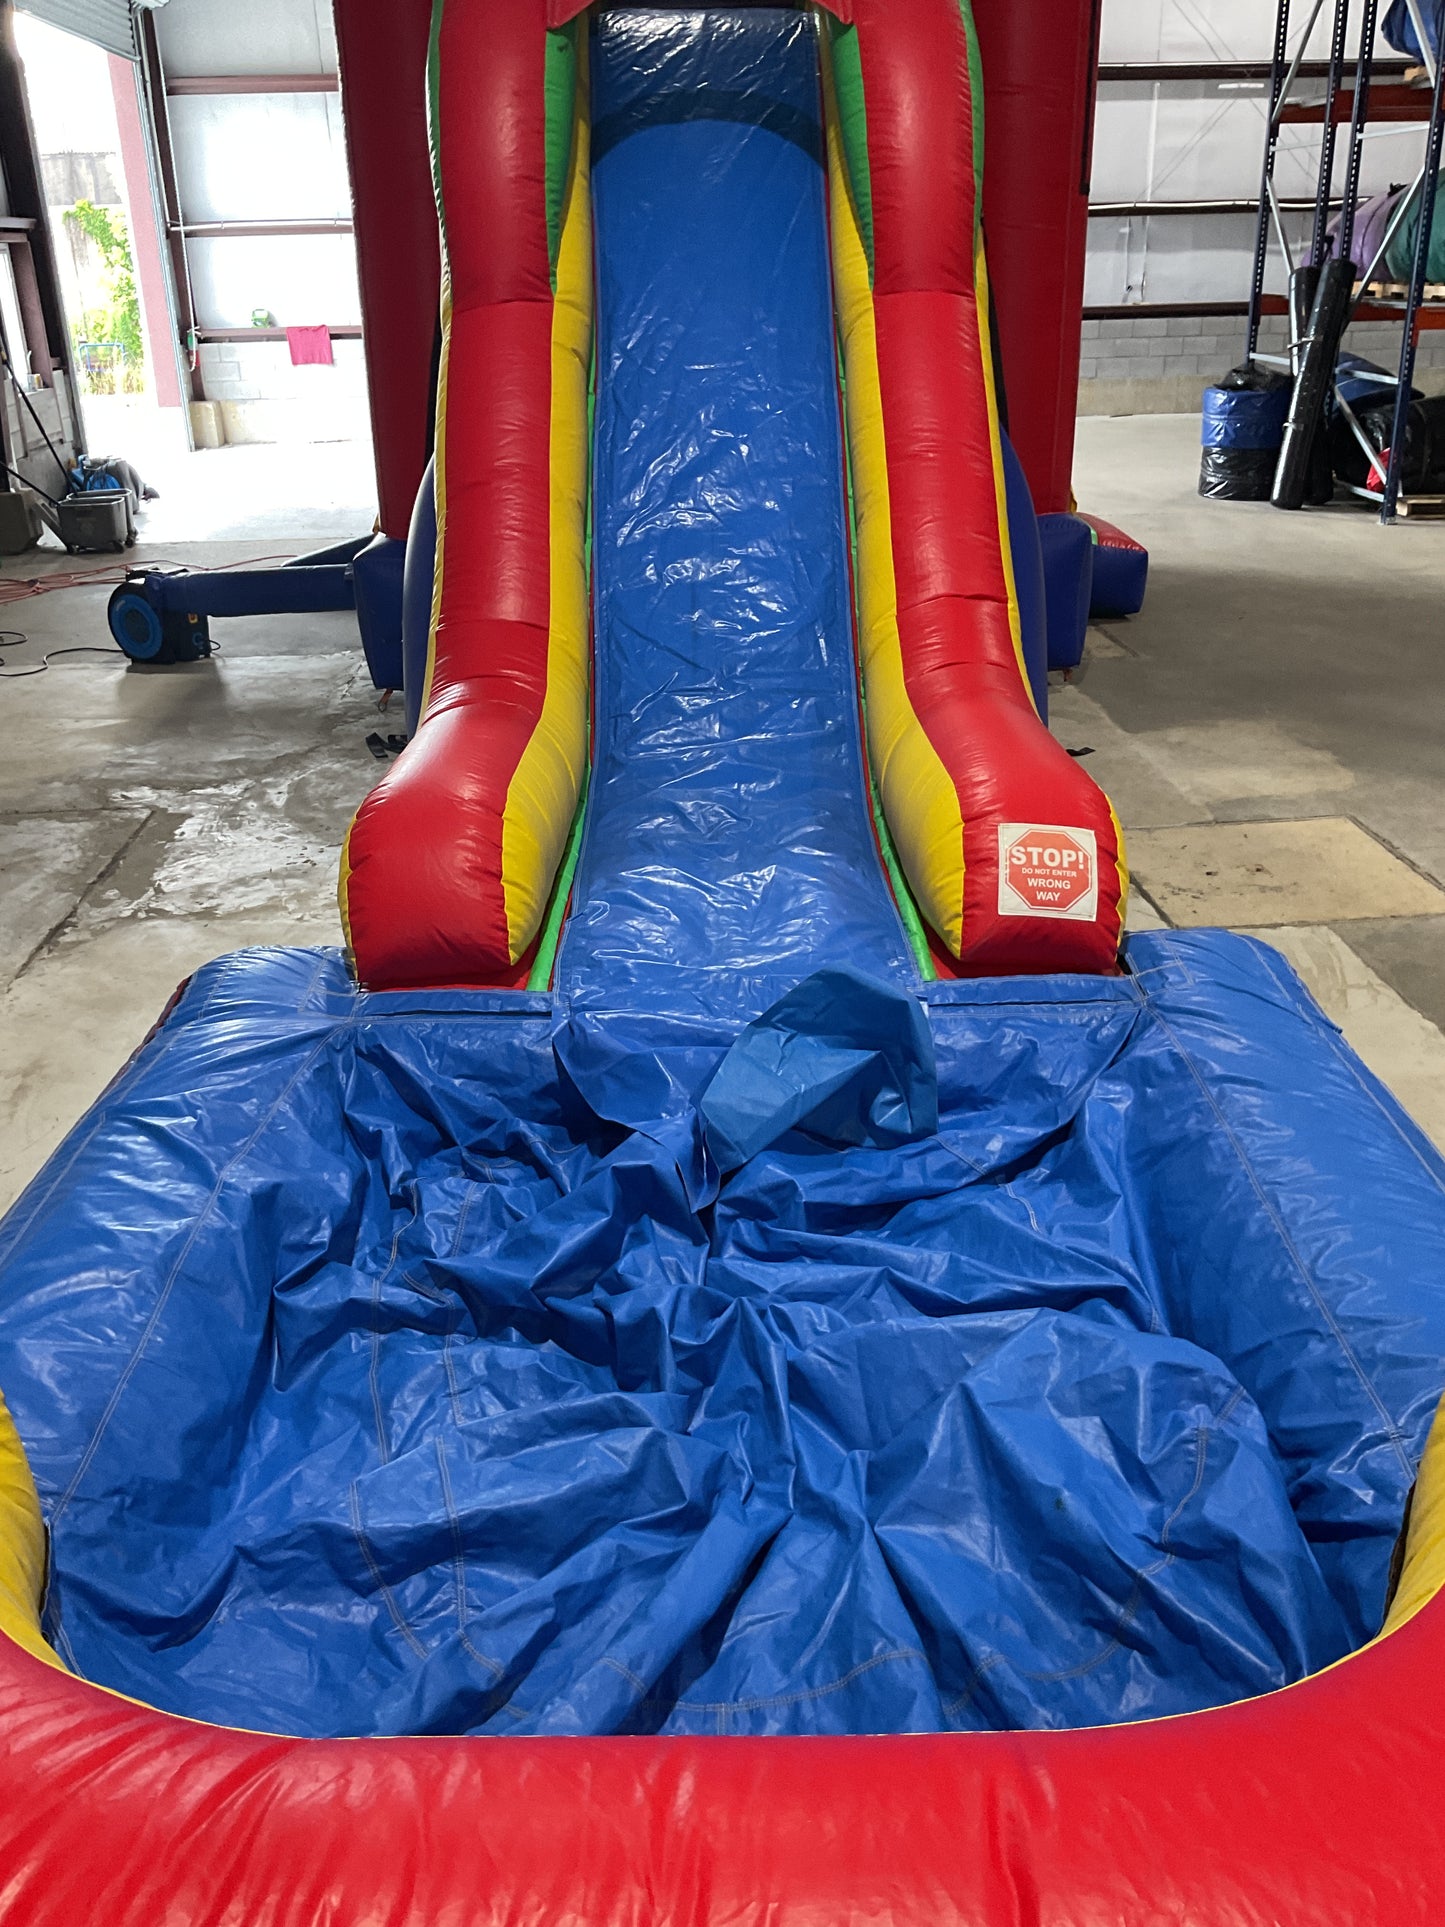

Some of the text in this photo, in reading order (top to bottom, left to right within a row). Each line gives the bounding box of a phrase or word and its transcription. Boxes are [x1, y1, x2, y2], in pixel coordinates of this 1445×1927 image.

[1010, 846, 1084, 870] STOP!
[1027, 878, 1071, 889] WRONG
[1036, 891, 1060, 901] WAY
